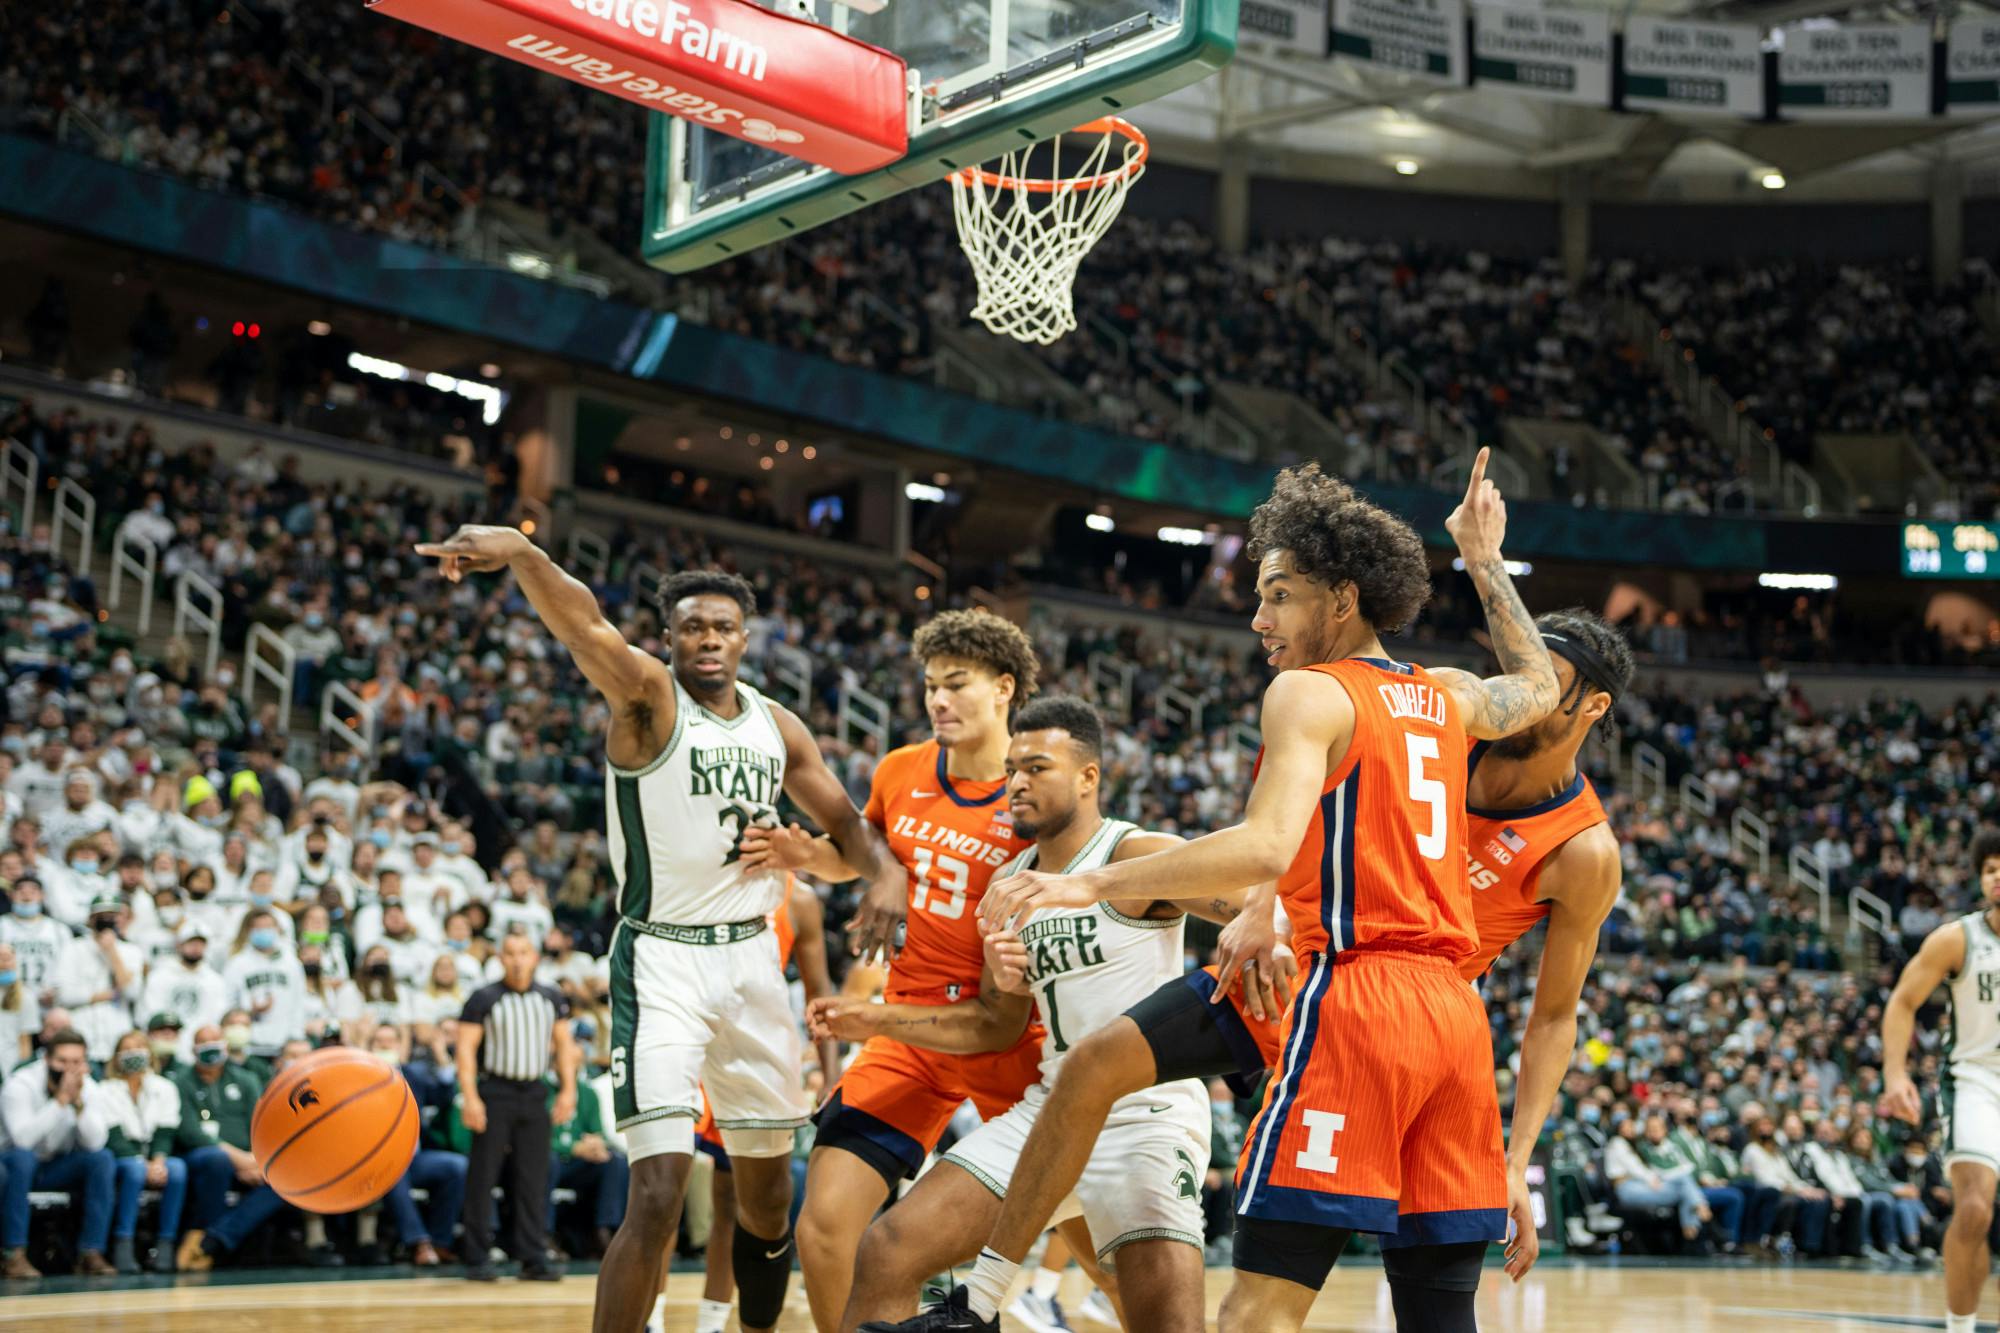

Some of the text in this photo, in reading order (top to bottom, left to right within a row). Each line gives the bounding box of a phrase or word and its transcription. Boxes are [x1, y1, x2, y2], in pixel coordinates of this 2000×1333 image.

[690, 746, 781, 805] STATE
[1404, 732, 1447, 860] 5
[893, 815, 1009, 867] ILLINOIS
[911, 846, 970, 920] 13
[715, 924, 730, 944] S
[1018, 917, 1072, 945] ICHIGAN
[1042, 979, 1069, 1052] 1
[611, 1046, 627, 1089] S
[1295, 1108, 1346, 1174] I
